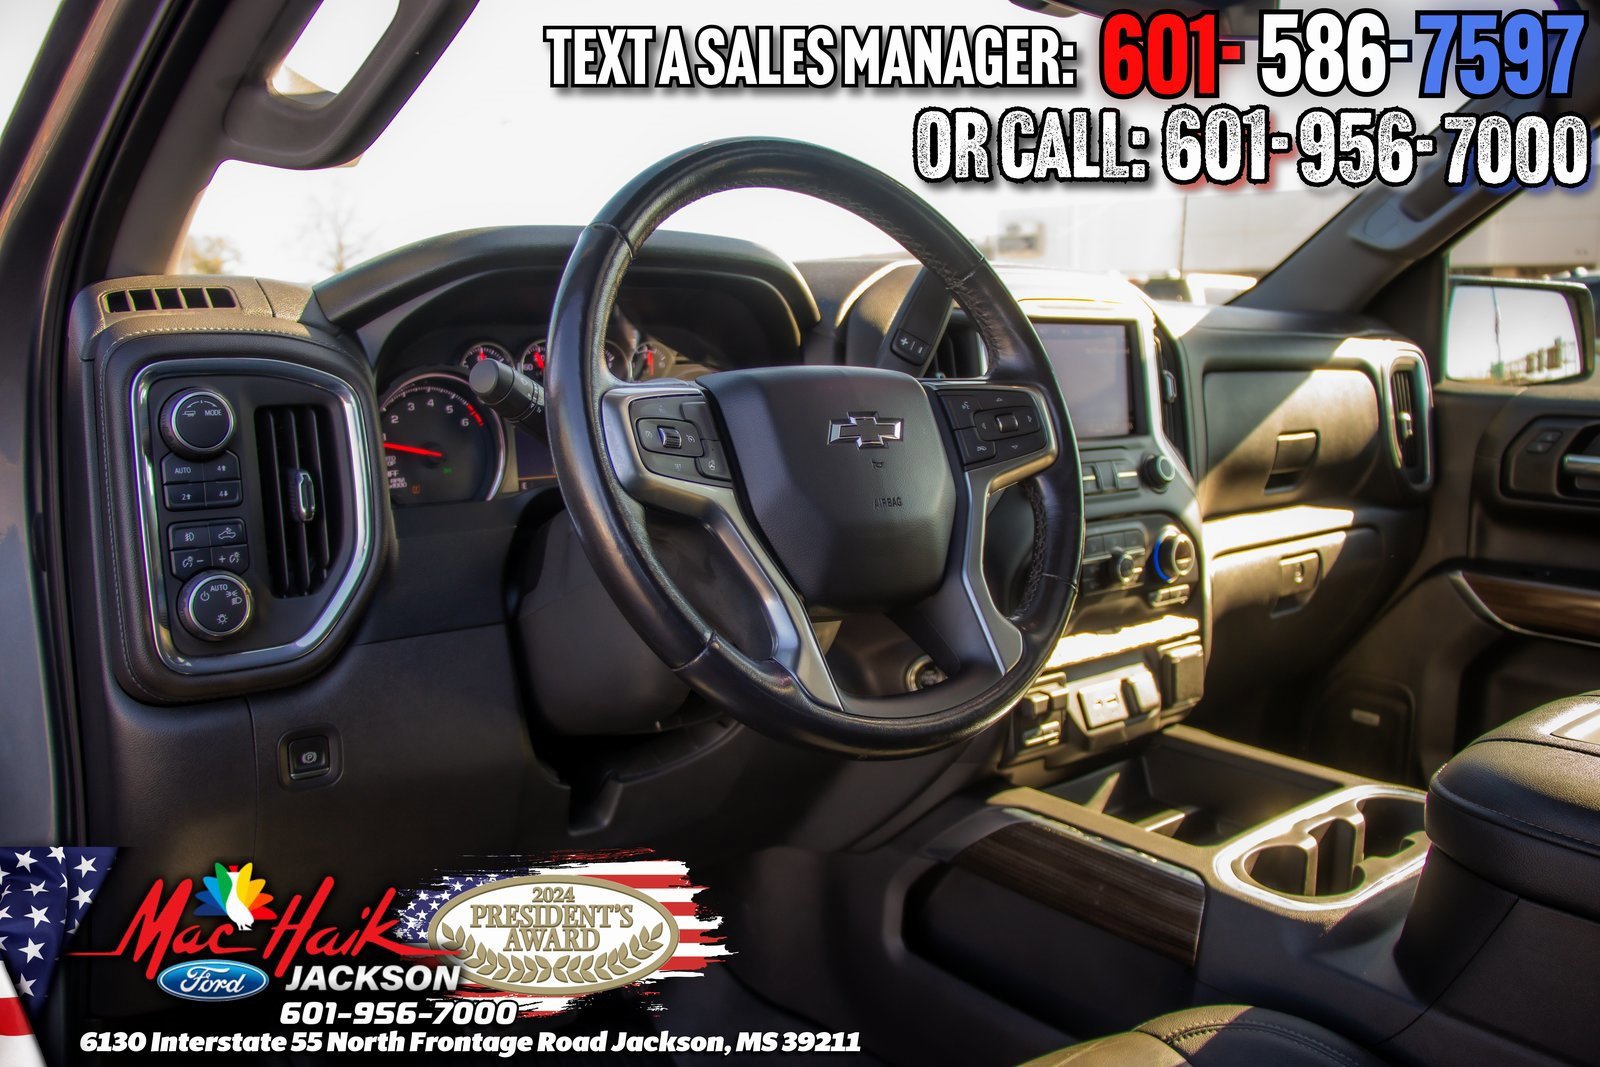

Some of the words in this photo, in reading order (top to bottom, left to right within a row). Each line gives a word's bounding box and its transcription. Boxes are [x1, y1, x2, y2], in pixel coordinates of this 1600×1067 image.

[407, 402, 415, 411] 3
[427, 399, 434, 407] 4
[445, 405, 454, 414] 5
[391, 415, 399, 424] 2
[461, 418, 469, 427] 6
[174, 466, 192, 474] AUTO
[874, 496, 903, 509] AIRBAG
[210, 583, 228, 592] AUTO
